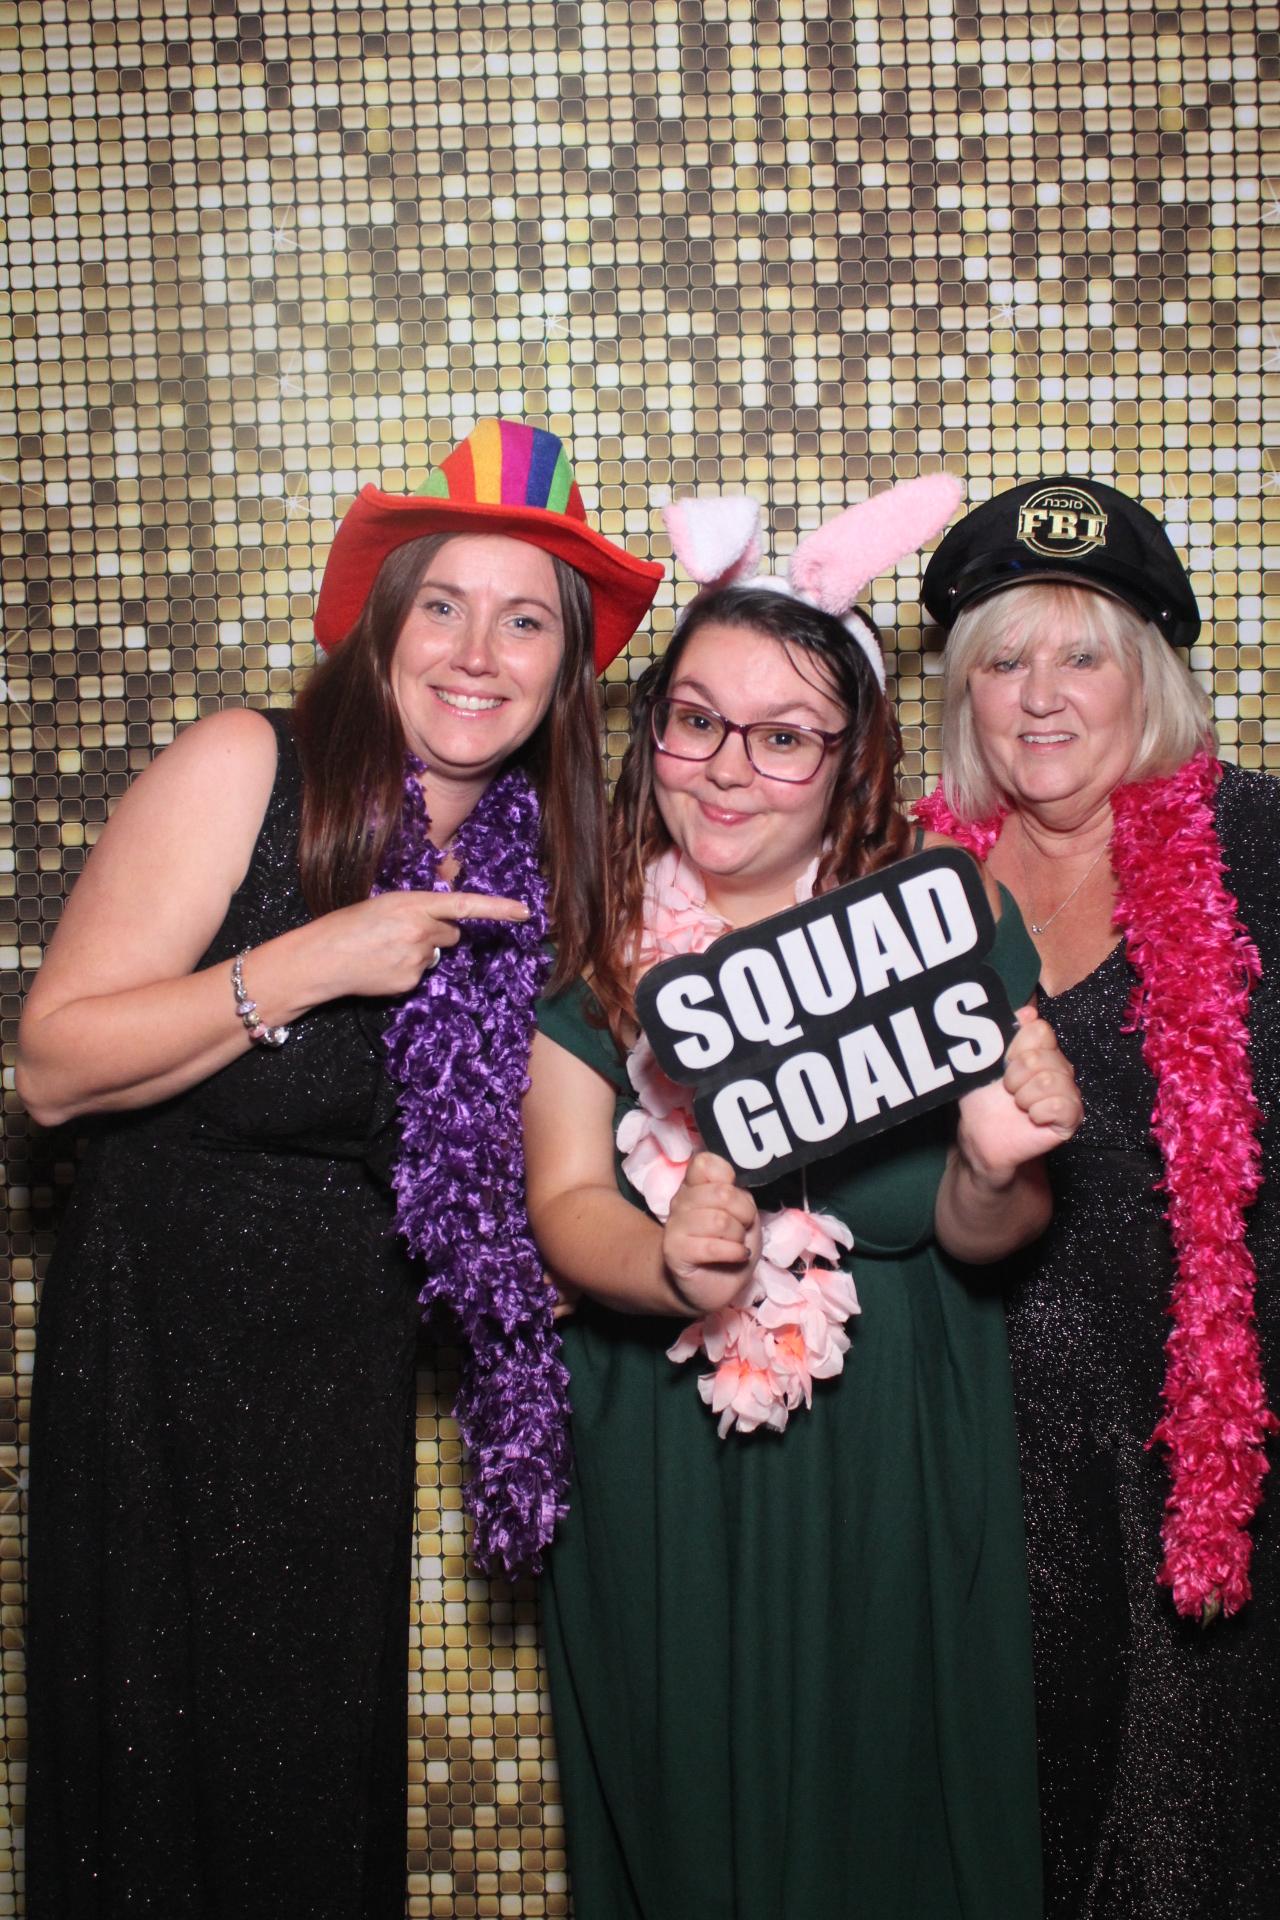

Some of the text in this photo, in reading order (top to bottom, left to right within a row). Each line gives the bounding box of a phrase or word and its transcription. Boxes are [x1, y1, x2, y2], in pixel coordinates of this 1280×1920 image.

[1017, 508, 1107, 545] FBI
[656, 868, 977, 1069] SQUAD
[713, 982, 1004, 1169] GOALS
